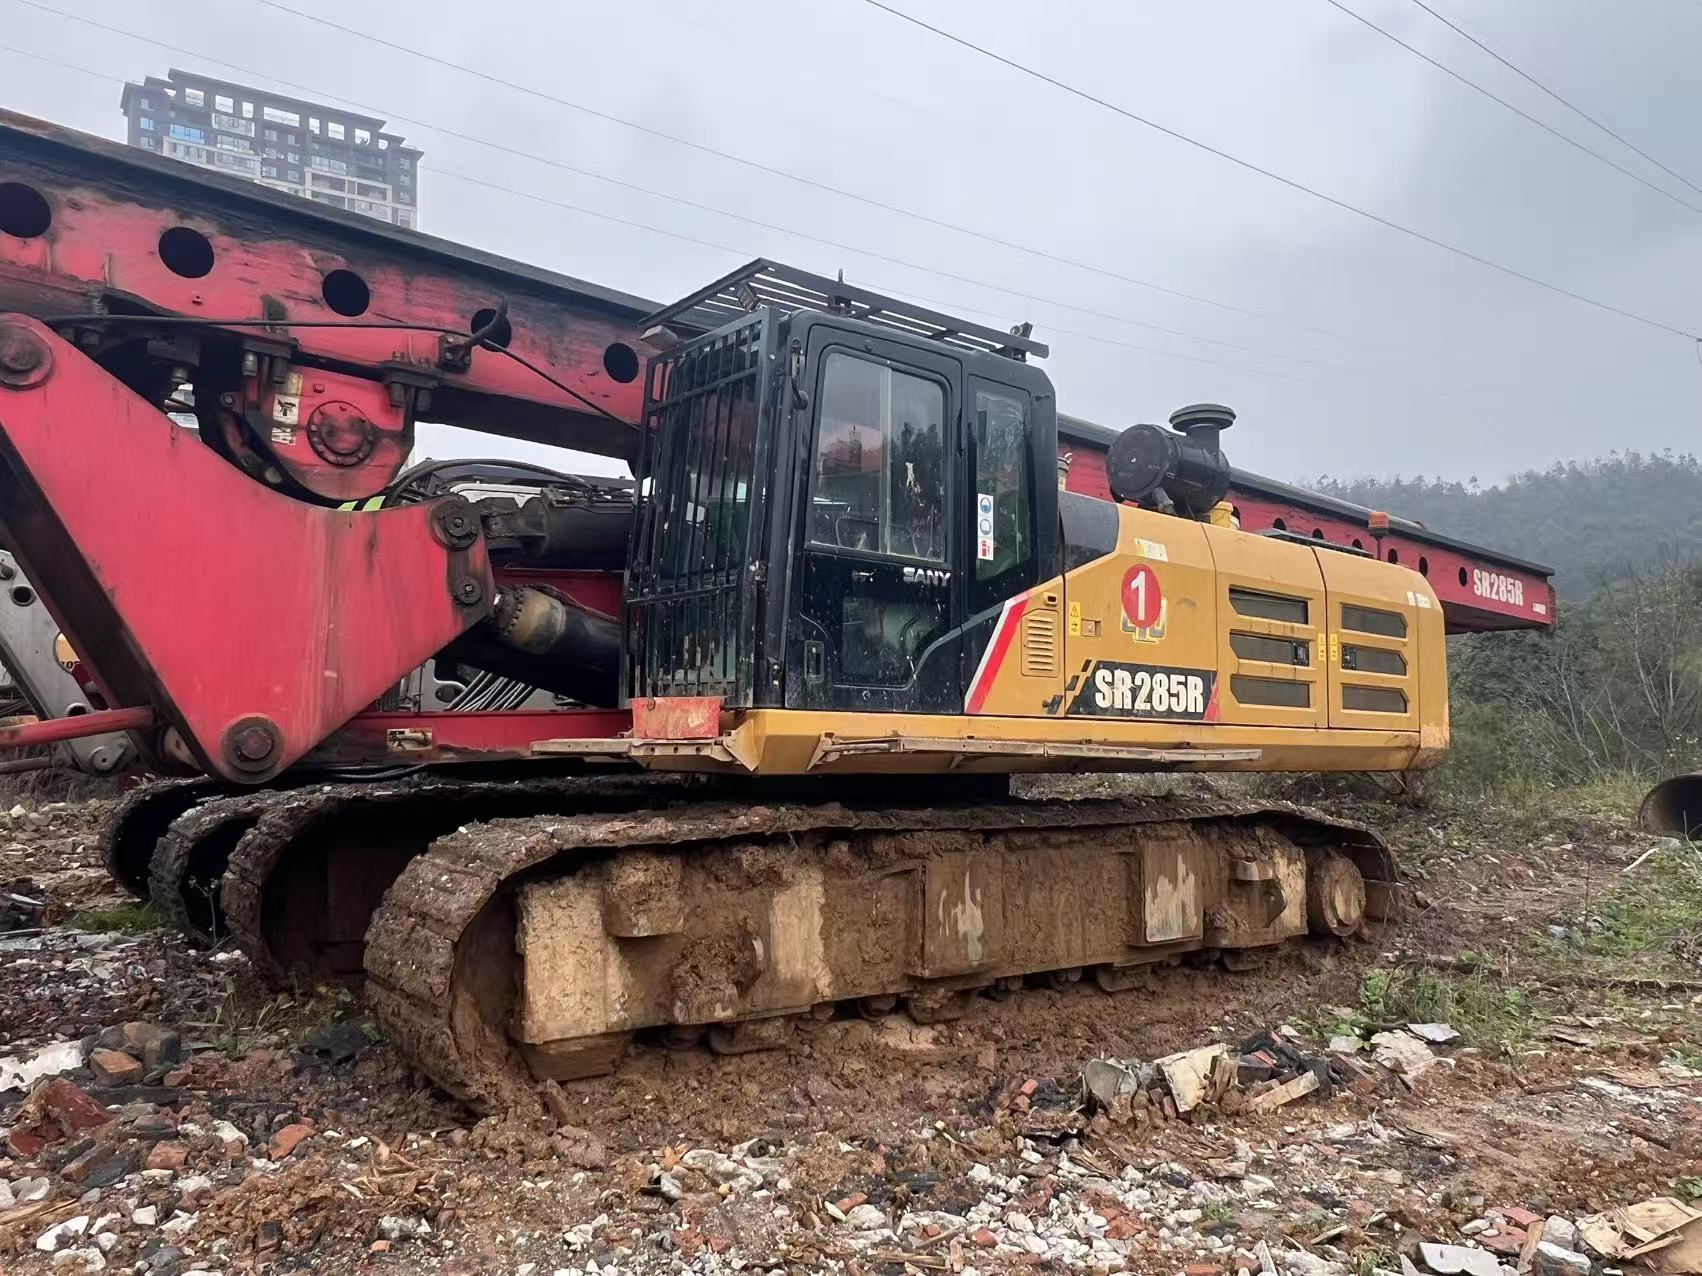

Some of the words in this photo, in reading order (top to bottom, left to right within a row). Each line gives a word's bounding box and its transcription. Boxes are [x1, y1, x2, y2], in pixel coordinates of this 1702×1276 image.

[903, 567, 951, 587] SANY
[1130, 570, 1146, 621] 1
[1473, 568, 1524, 606] SR285R
[1094, 669, 1204, 713] SR285R
